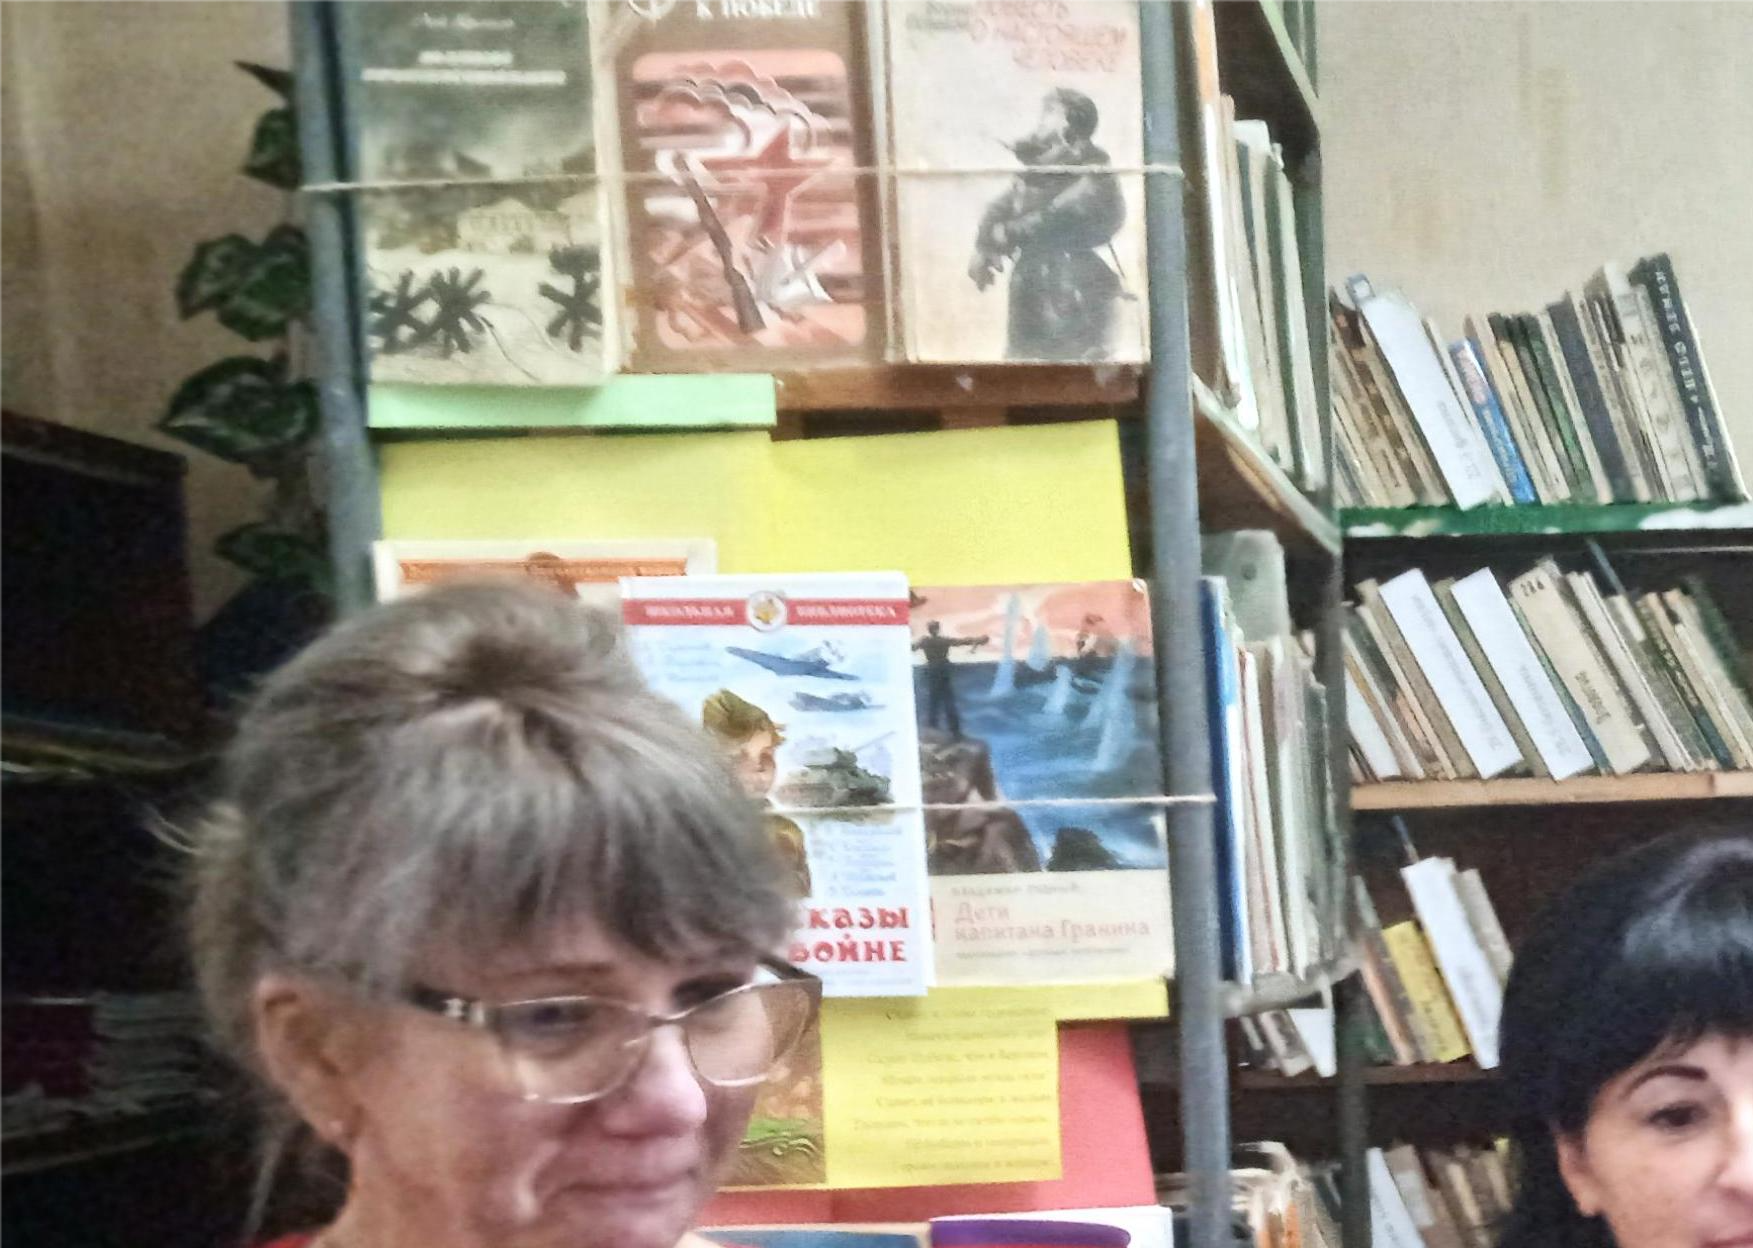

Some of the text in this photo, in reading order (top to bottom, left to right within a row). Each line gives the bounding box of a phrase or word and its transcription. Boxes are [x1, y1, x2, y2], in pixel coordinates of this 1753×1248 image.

[954, 902, 1010, 924] Дети
[954, 920, 1151, 944] капитана Гранина
